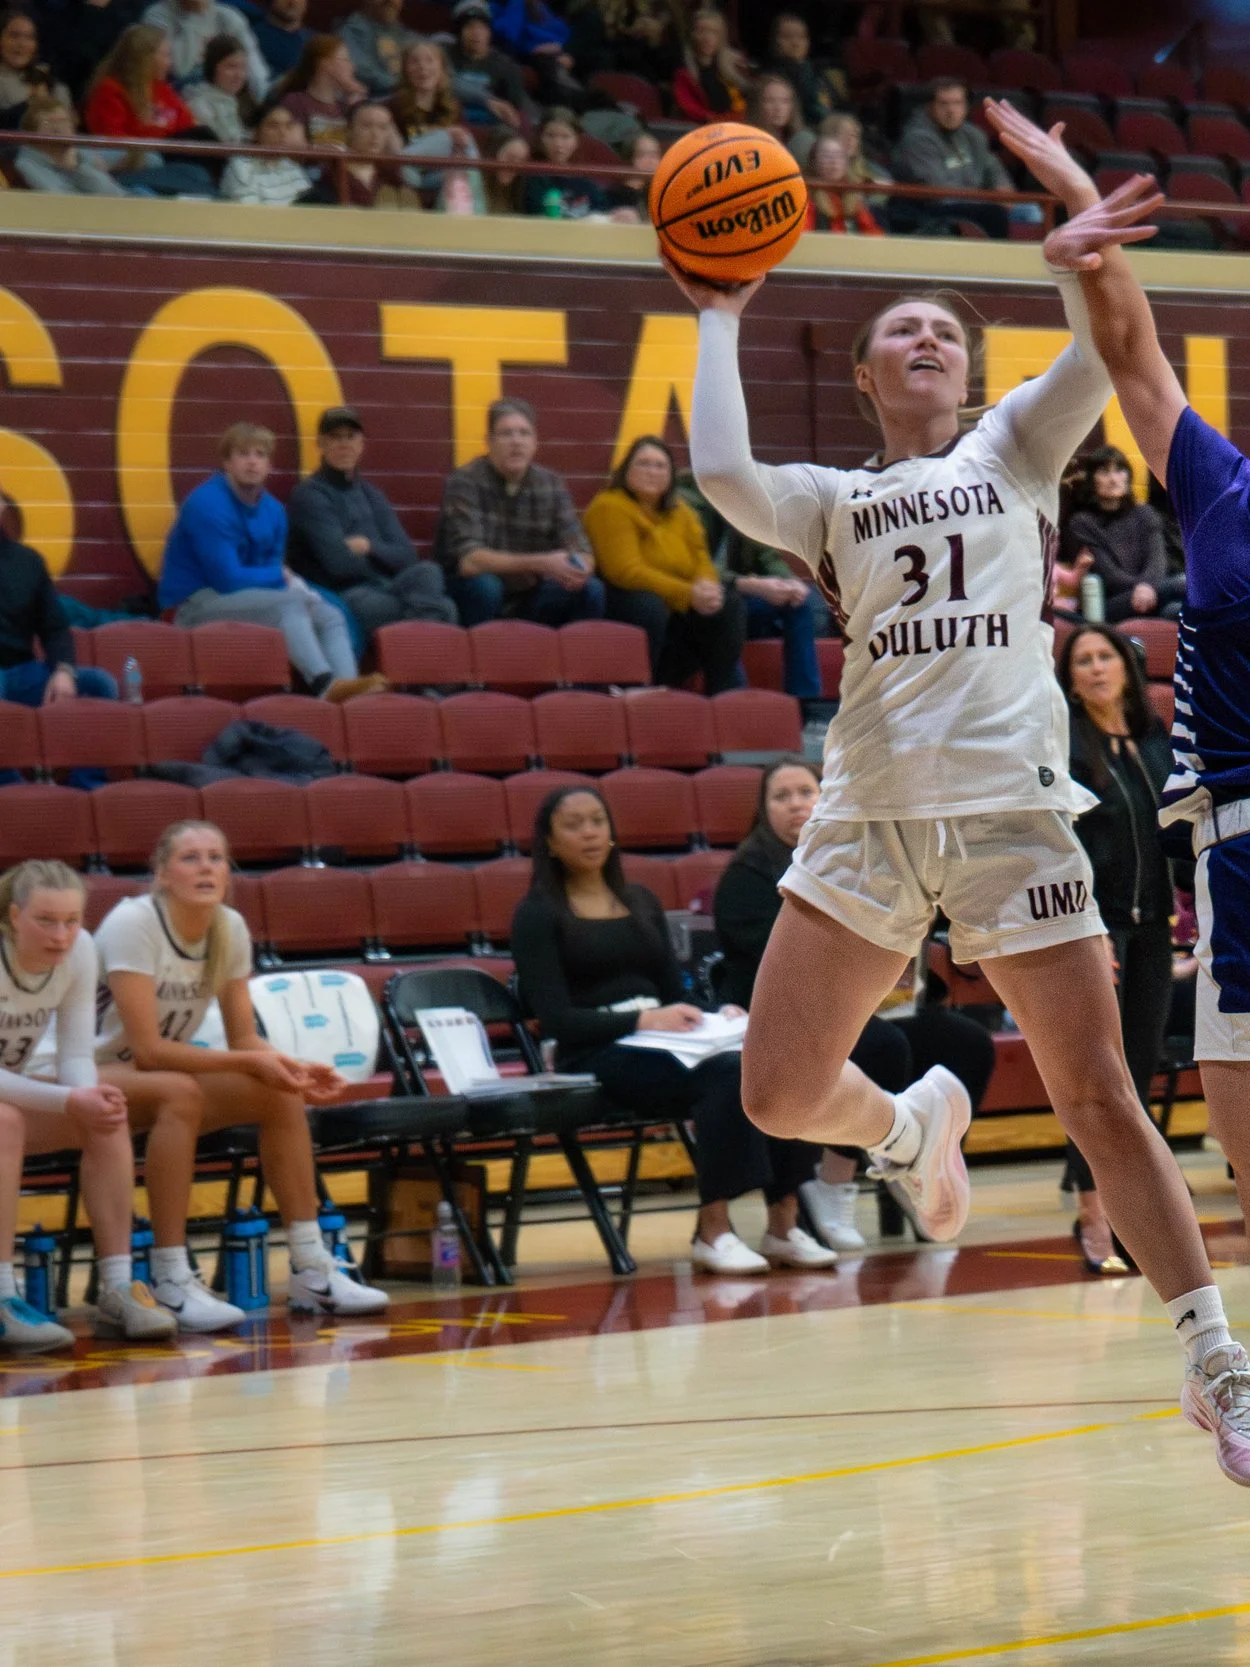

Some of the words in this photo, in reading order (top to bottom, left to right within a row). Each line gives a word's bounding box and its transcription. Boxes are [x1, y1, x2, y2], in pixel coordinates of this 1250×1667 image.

[703, 150, 761, 188] EVO
[695, 190, 797, 240] Wilson
[852, 482, 1005, 544] MINNESOTA
[894, 533, 969, 607] 31
[868, 613, 1010, 661] DULUTH
[1027, 879, 1088, 921] UMD
